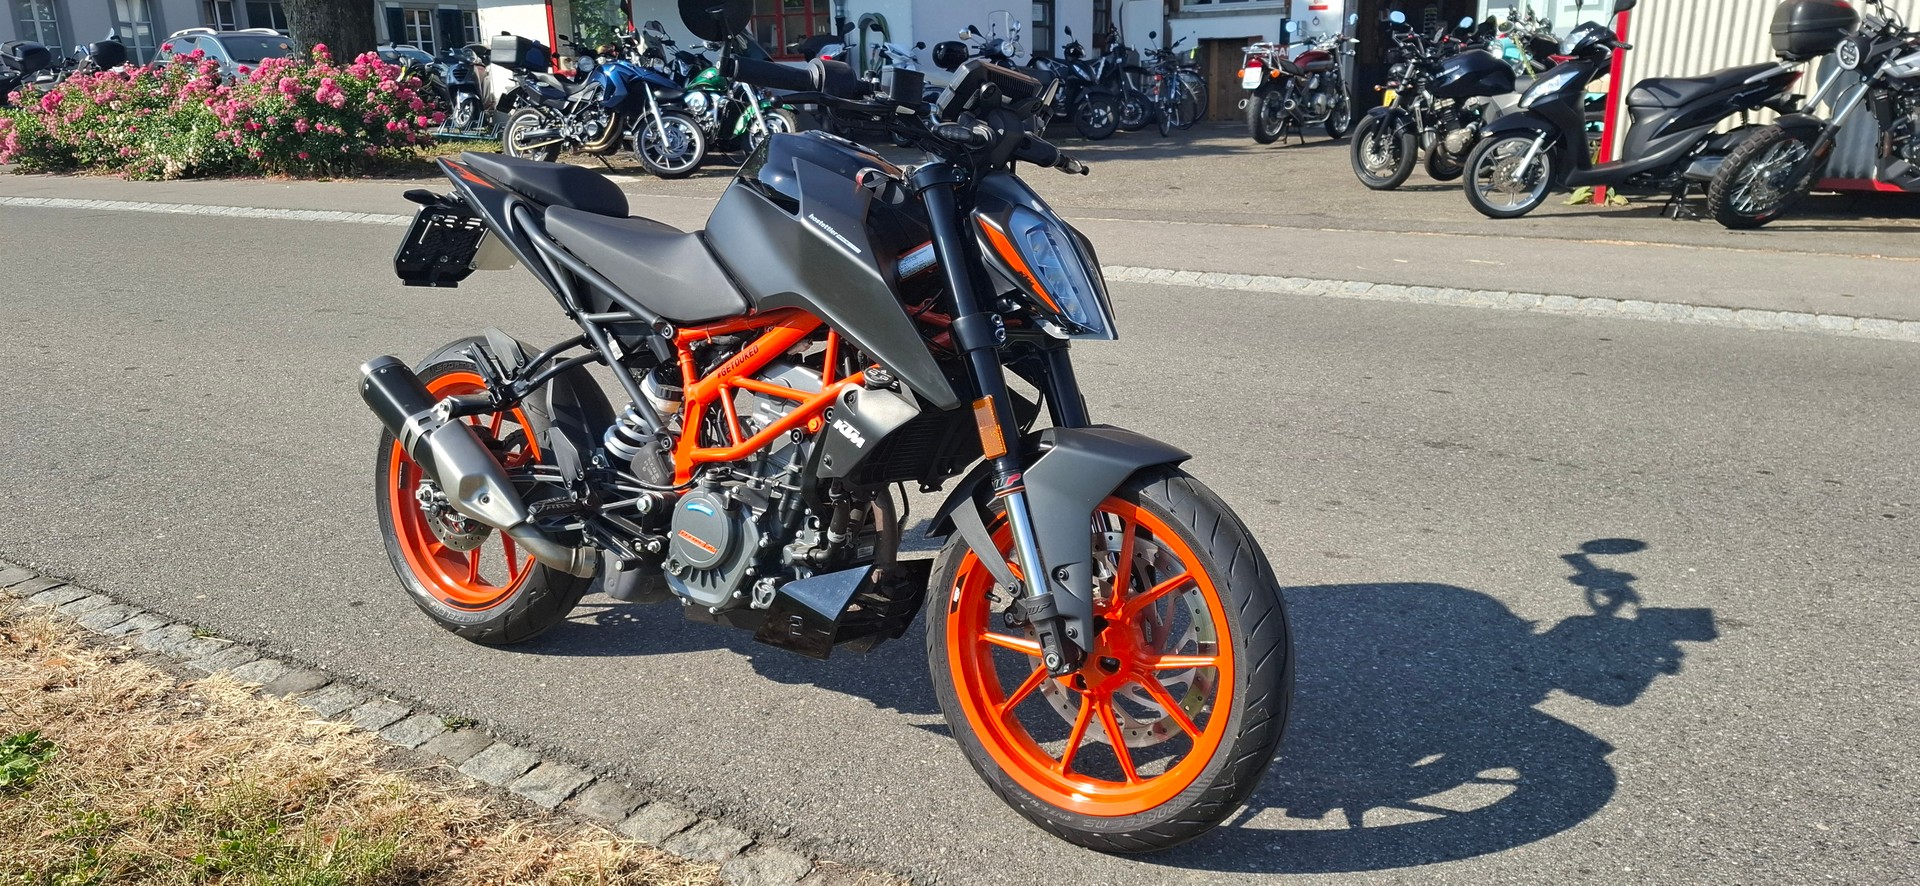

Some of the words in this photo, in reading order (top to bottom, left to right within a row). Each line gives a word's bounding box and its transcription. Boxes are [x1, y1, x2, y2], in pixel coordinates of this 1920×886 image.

[808, 214, 838, 237] hostettler
[833, 419, 866, 449] KTM
[433, 605, 479, 623] METZELER
[1112, 798, 1187, 829] SPORTEC
